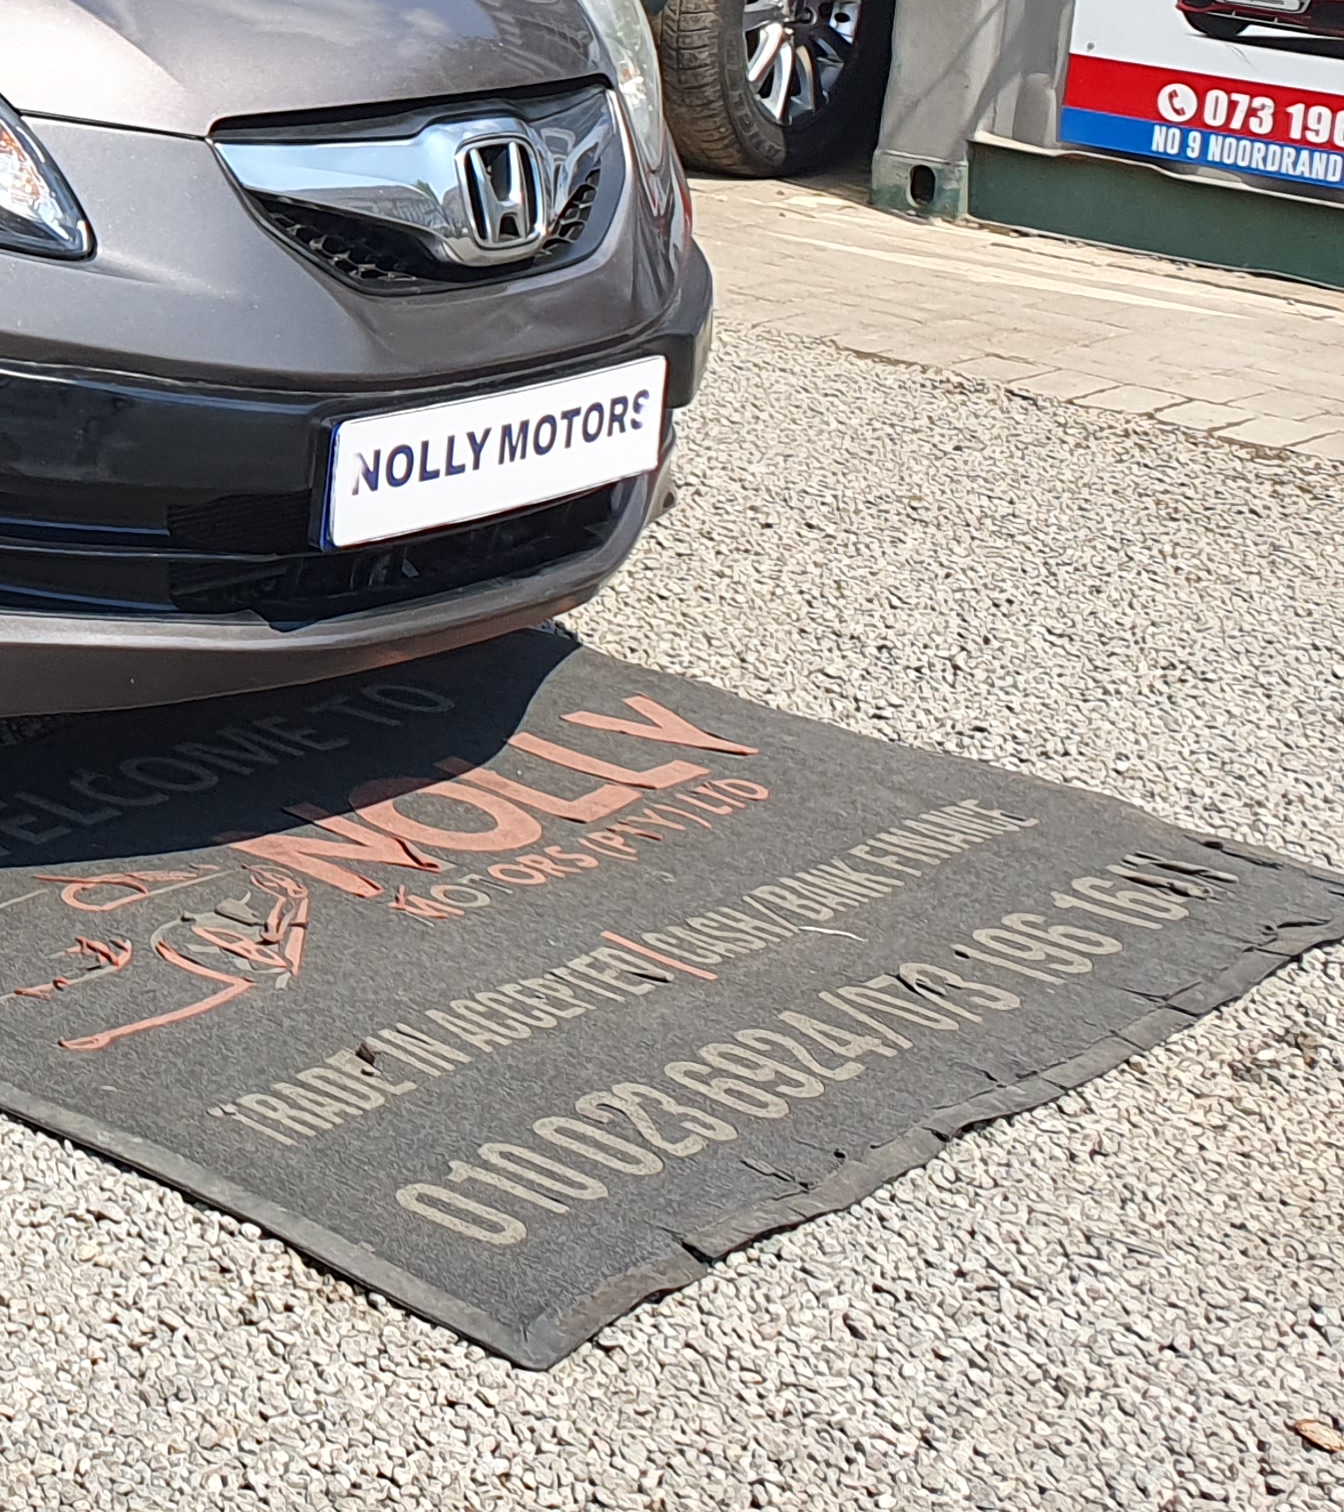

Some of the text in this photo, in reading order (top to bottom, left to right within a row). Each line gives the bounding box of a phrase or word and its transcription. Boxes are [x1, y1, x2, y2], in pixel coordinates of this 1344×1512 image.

[1151, 124, 1343, 183] NO 9 NOORDRAND
[1203, 89, 1276, 135] 073
[351, 389, 650, 496] NOLLY MOTORS
[308, 684, 455, 727] TO
[212, 693, 760, 898] NOLLY
[641, 799, 1040, 965] CASH/BANK FINANCE
[208, 946, 675, 1146] TRADE IN ACCEPTED
[395, 1142, 610, 1246] 010
[533, 1082, 739, 1178] 023
[950, 912, 1124, 986] 196
